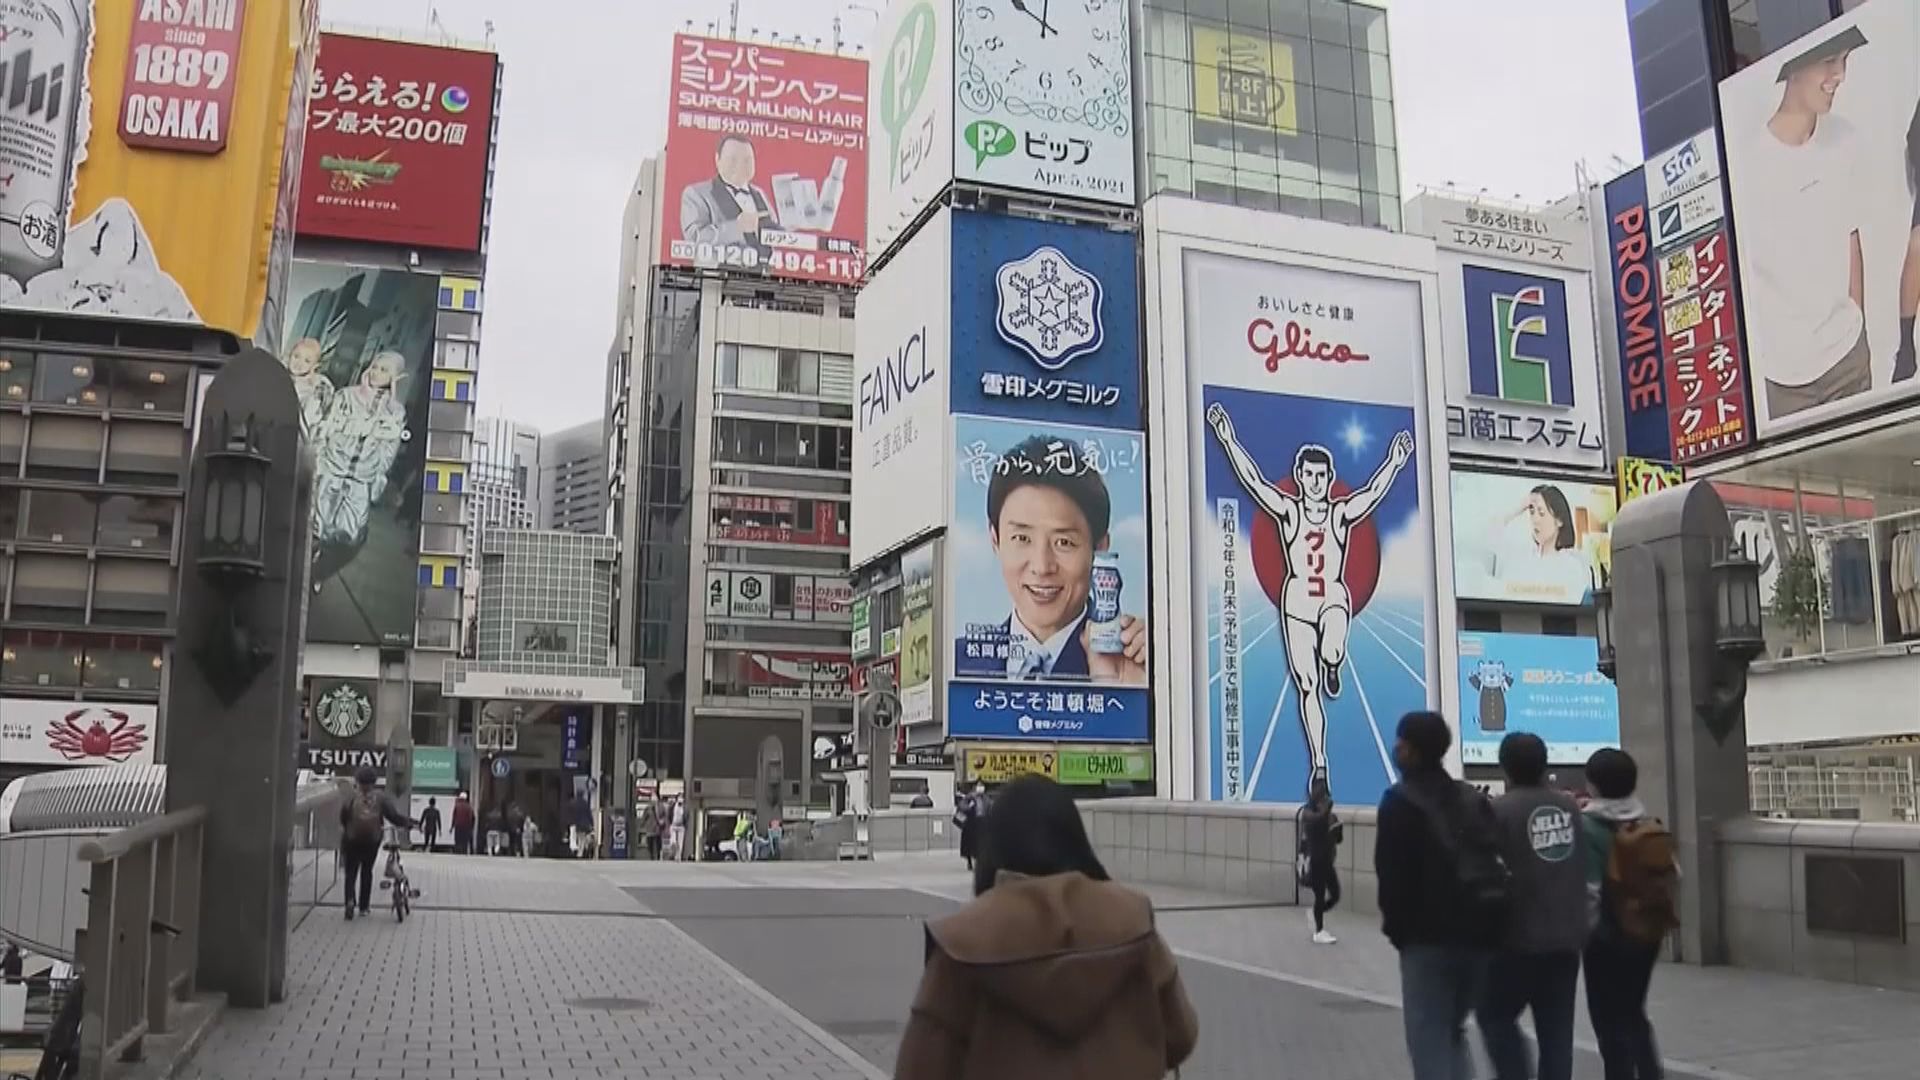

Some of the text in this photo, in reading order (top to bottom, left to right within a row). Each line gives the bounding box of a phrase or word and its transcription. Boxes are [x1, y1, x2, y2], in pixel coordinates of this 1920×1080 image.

[139, 0, 237, 31] ASAHI
[164, 27, 206, 46] since
[680, 38, 785, 72] スーパー
[134, 43, 229, 90] 1889
[680, 63, 864, 105] ミリオンヘアー
[1039, 71, 1053, 90] 6
[126, 93, 219, 142] OSAKA
[306, 108, 468, 146] ブ最大200個
[679, 91, 864, 128] SUPER MILLION HAIR
[900, 108, 936, 185] ピップ
[1025, 130, 1093, 165] ピップ
[1086, 176, 1124, 194] 2021
[23, 214, 58, 249] お酒
[1465, 207, 1548, 235] 夢ある住まい
[1453, 228, 1564, 262] エステムシリーズ
[1257, 295, 1354, 321] おいしさと健康
[1614, 203, 1662, 412] PROMISE
[1696, 234, 1738, 425] インターネット
[860, 326, 935, 433] FANCL
[982, 372, 1120, 406] 雪印メグミルク
[1672, 328, 1703, 435] コミック
[1447, 405, 1603, 450] 日商エステム
[960, 438, 1140, 486] 骨から、元気に!
[1304, 527, 1326, 598] グリコ
[974, 690, 1125, 714] ようこそ道頓堀へ
